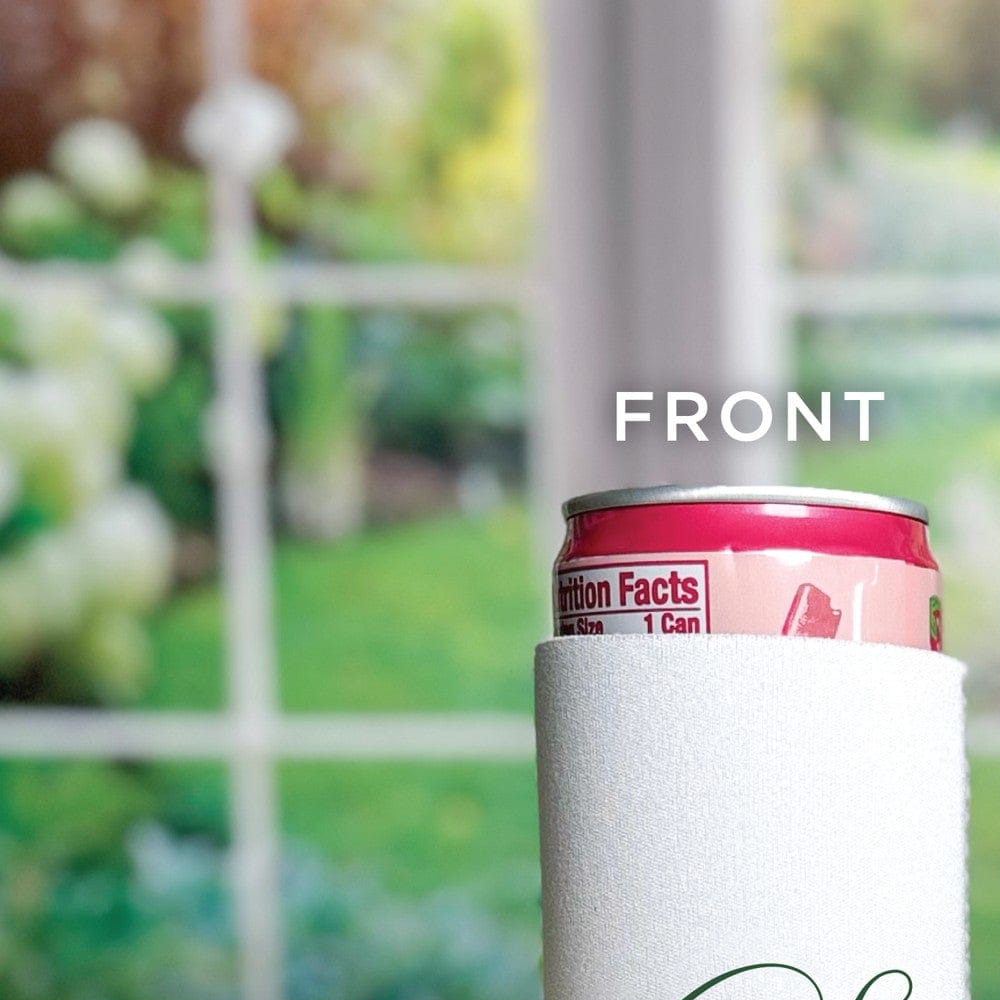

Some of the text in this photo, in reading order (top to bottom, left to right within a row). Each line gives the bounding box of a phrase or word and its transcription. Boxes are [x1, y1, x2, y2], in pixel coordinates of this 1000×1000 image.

[619, 571, 699, 607] Facts
[644, 612, 700, 634] 1 Can
